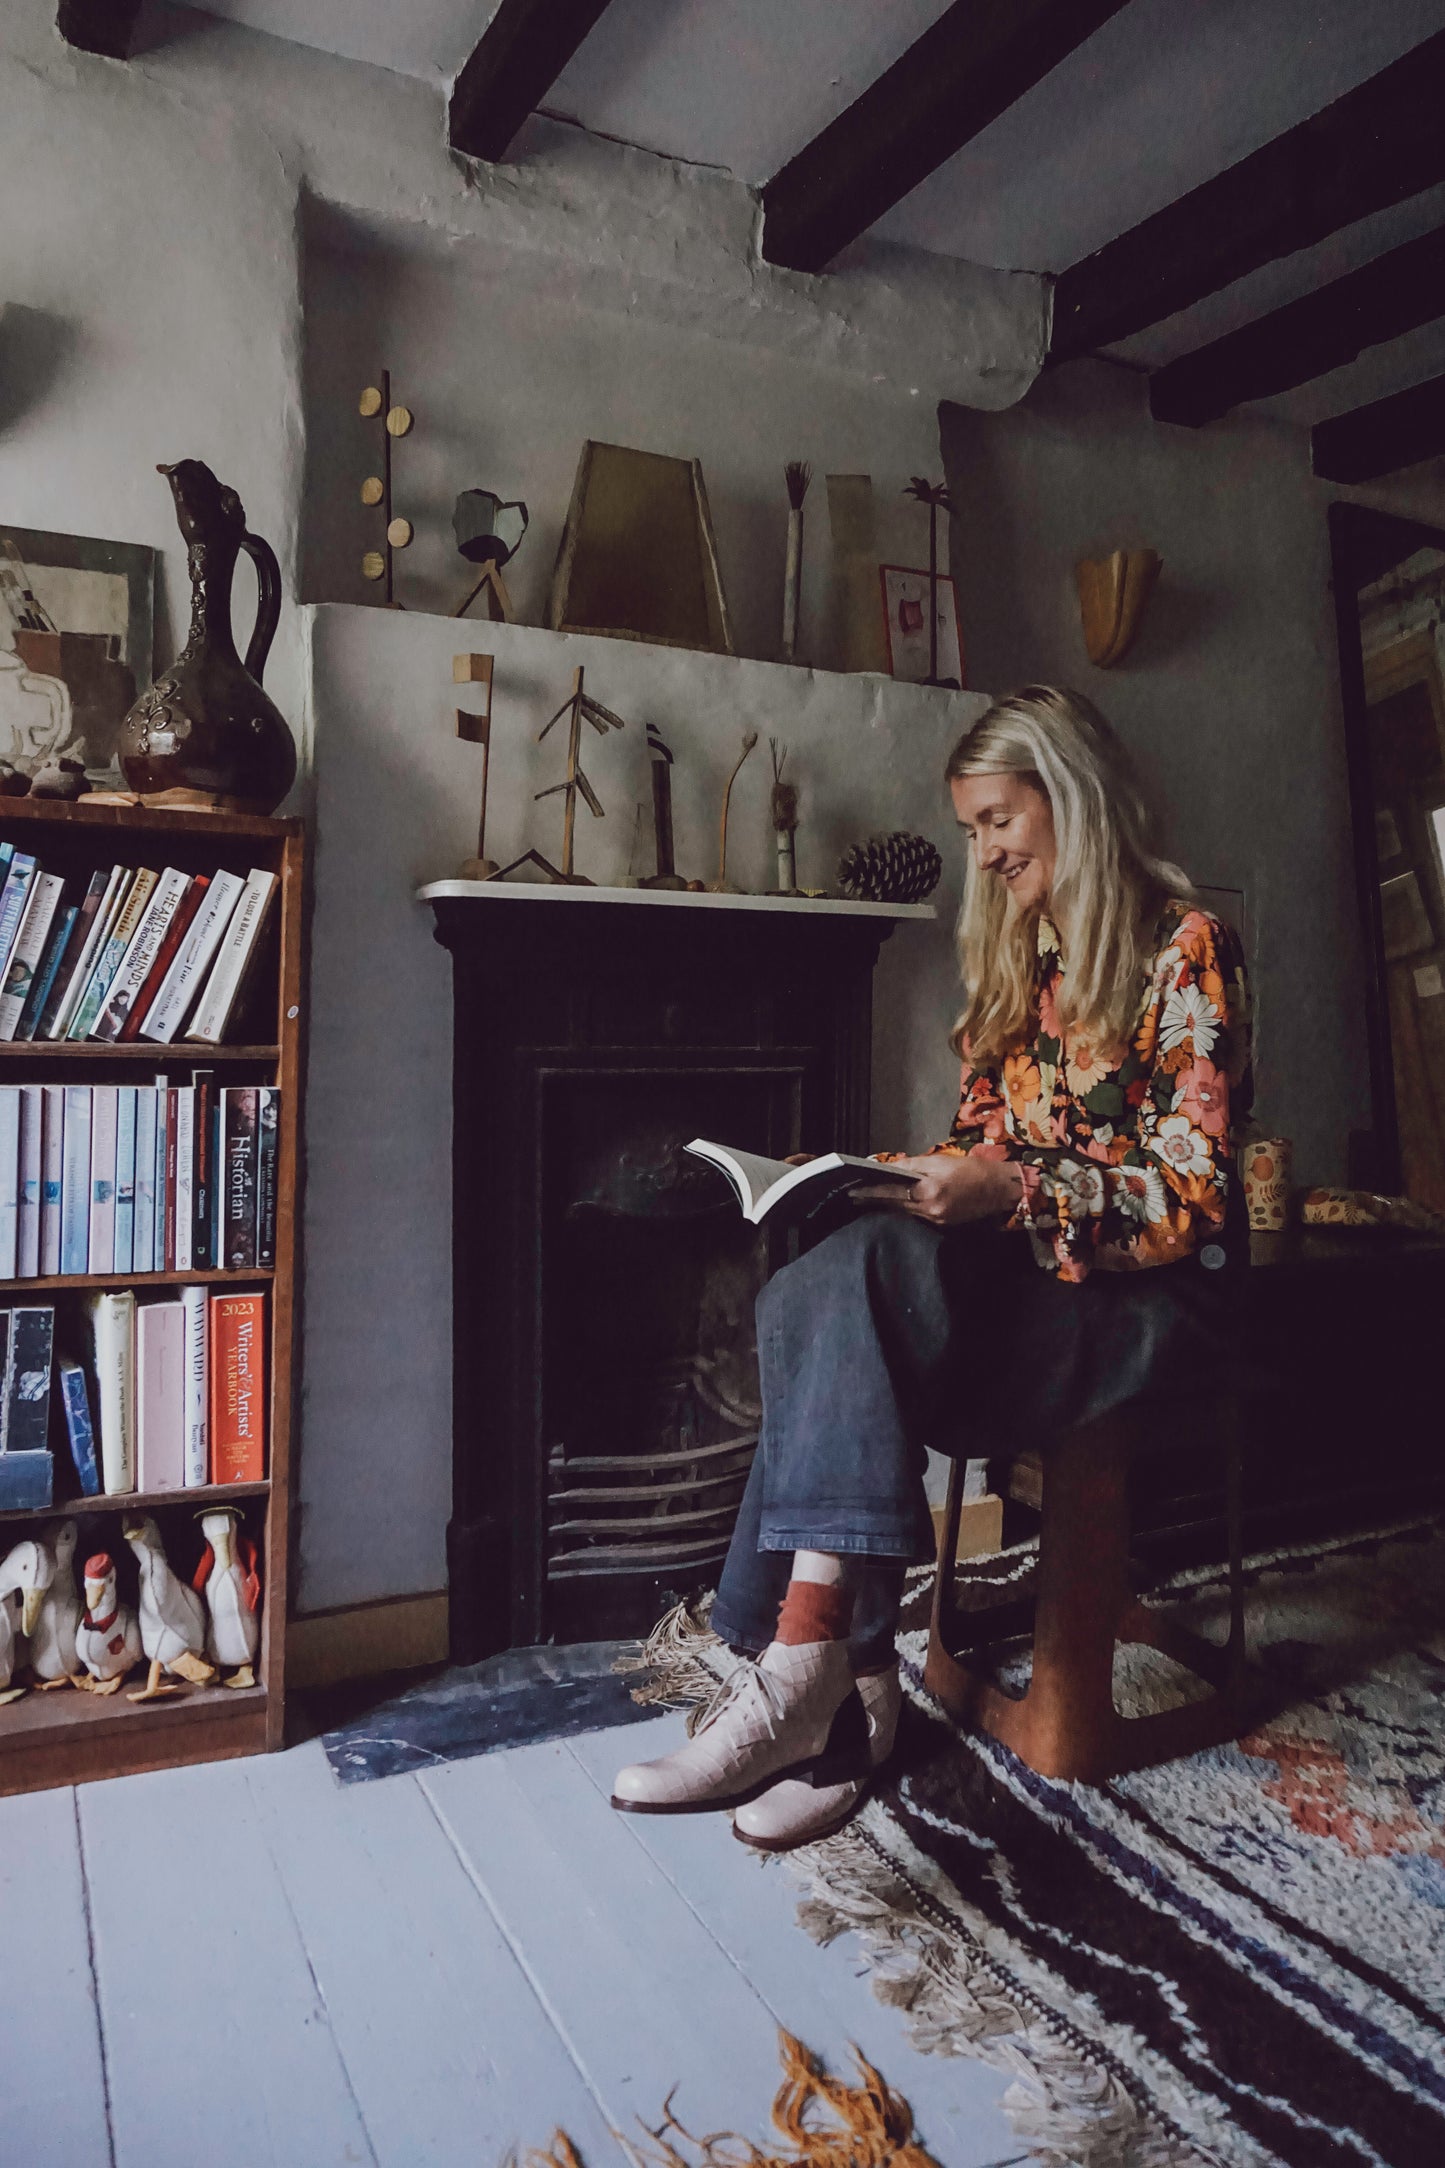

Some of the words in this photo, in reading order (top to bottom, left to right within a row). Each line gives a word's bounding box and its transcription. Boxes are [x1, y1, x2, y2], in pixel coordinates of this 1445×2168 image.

[118, 895, 141, 933] Smith
[144, 905, 160, 927] JANE
[151, 891, 179, 936] HEARTS
[245, 900, 257, 916] LOSE
[126, 926, 151, 968] ROBINSON
[145, 935, 157, 951] AND
[233, 922, 249, 948] BATTLE
[127, 951, 151, 987] MINDS
[230, 1135, 251, 1221] Historian
[222, 1302, 255, 1316] 2023
[193, 1302, 205, 1382] WAYWARD
[227, 1346, 238, 1416] YEARBOOK
